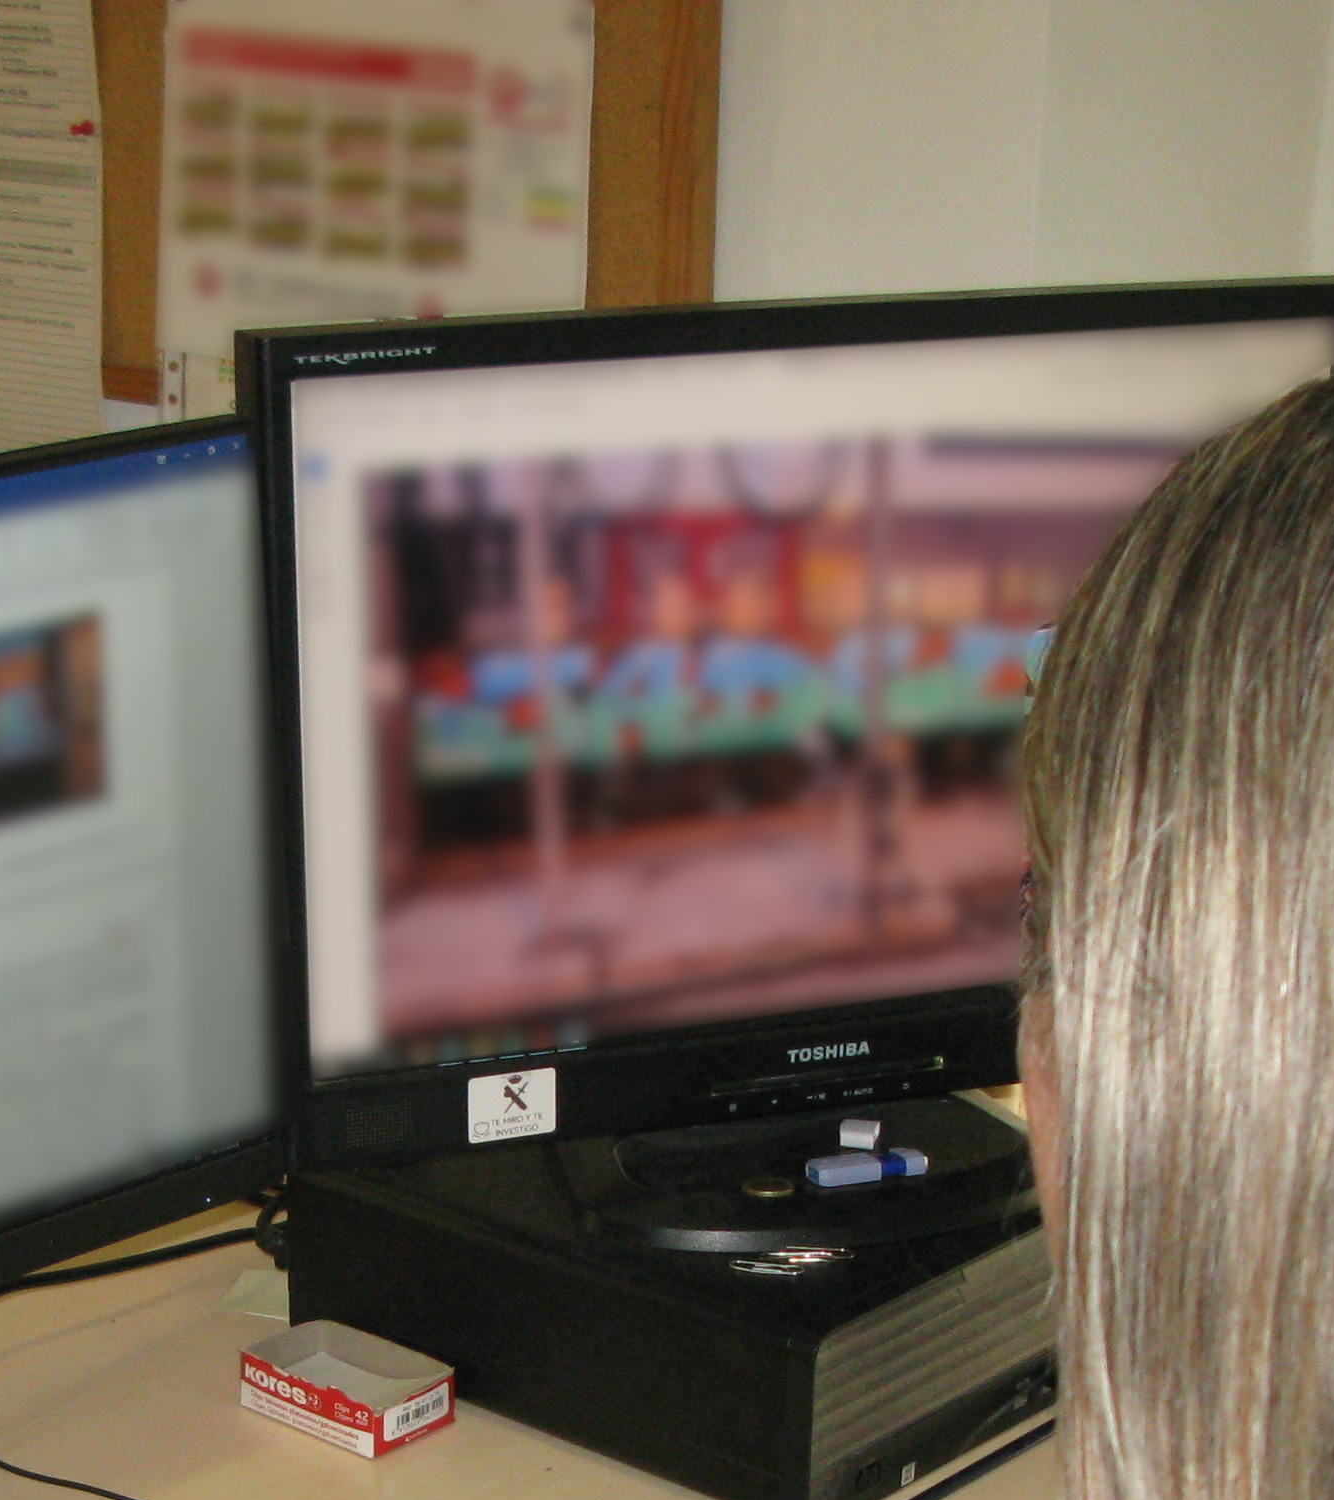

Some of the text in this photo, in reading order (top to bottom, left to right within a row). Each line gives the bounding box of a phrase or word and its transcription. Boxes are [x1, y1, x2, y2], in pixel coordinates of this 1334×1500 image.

[293, 346, 436, 365] TEKBRIGHT
[787, 1041, 871, 1064] TOSHIBA
[503, 1115, 524, 1124] MIRO
[534, 1112, 544, 1120] TE
[495, 1124, 539, 1136] INVESTIGO
